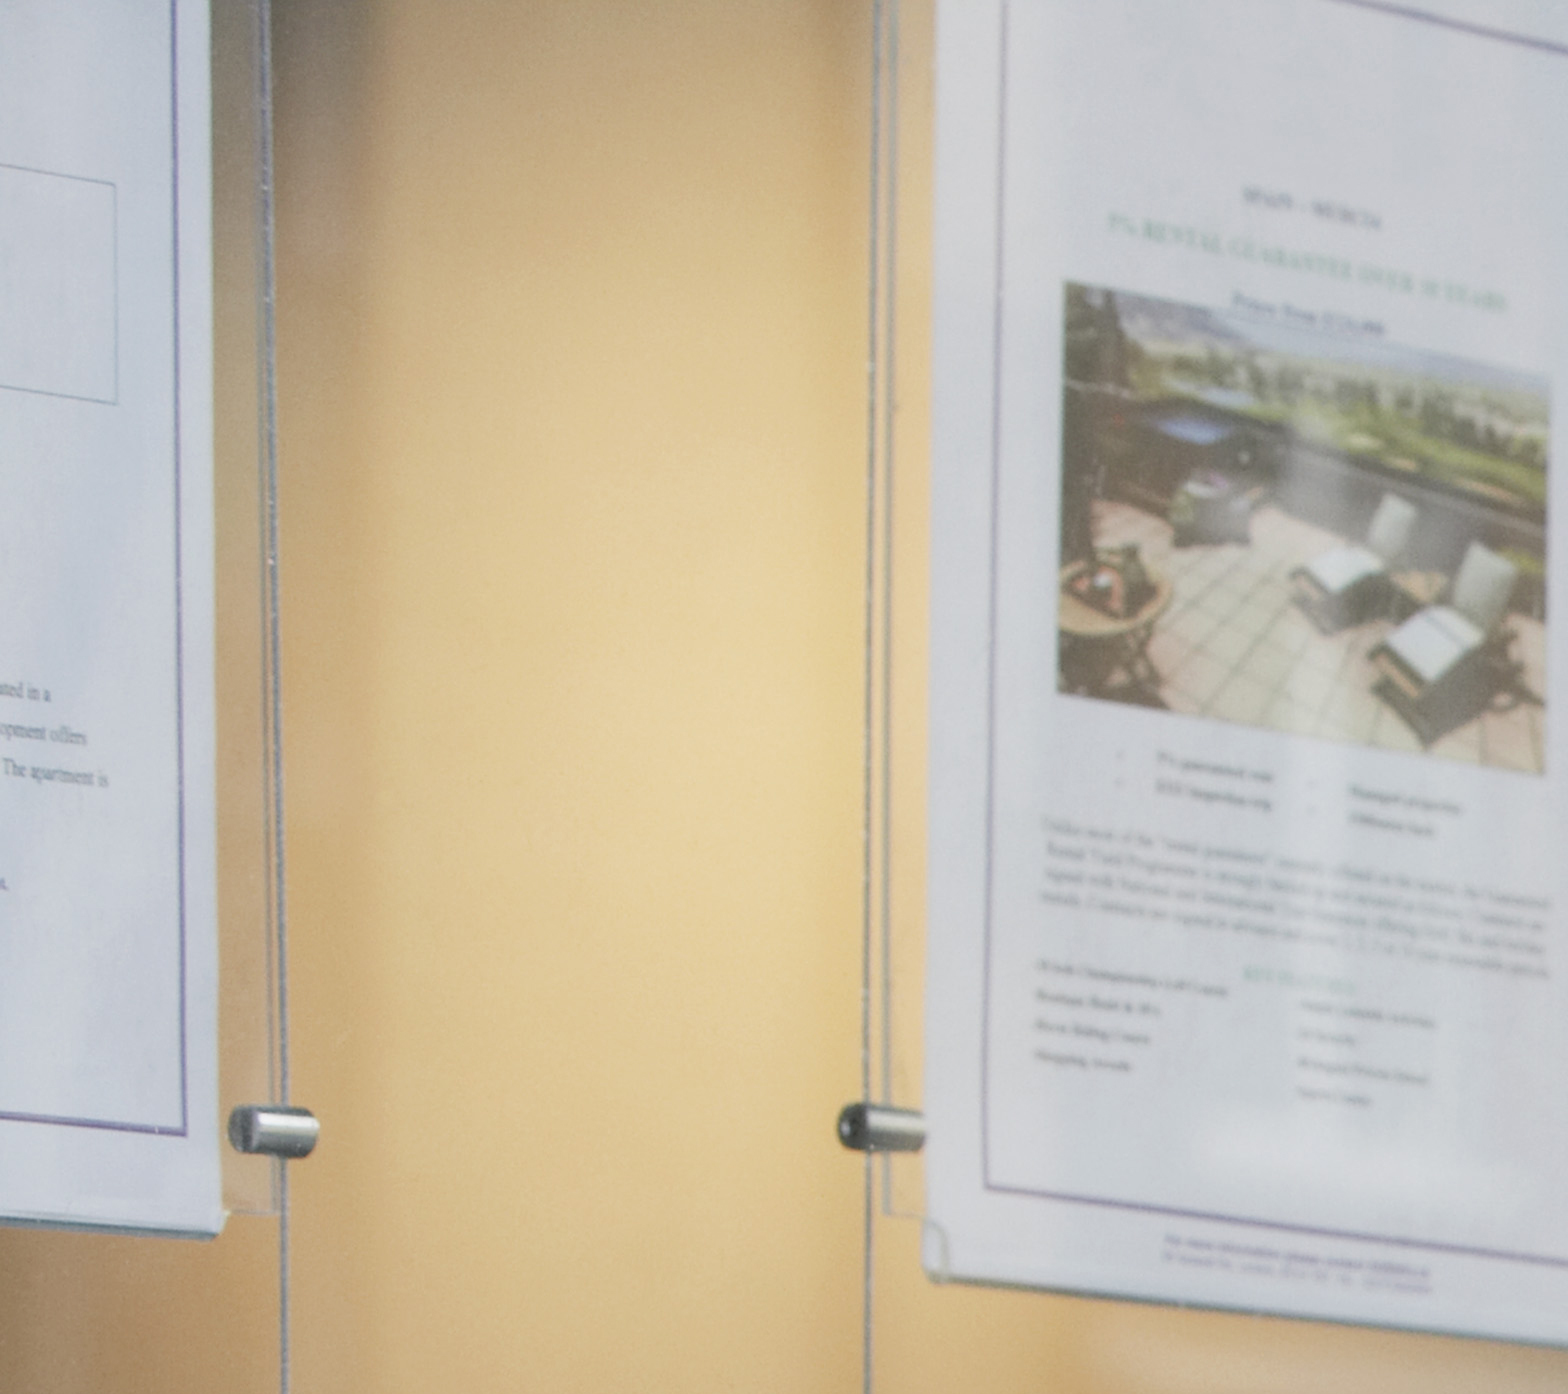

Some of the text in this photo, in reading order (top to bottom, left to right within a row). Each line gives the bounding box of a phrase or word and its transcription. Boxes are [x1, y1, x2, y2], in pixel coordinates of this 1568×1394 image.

[3, 757, 109, 788] The apartment is
